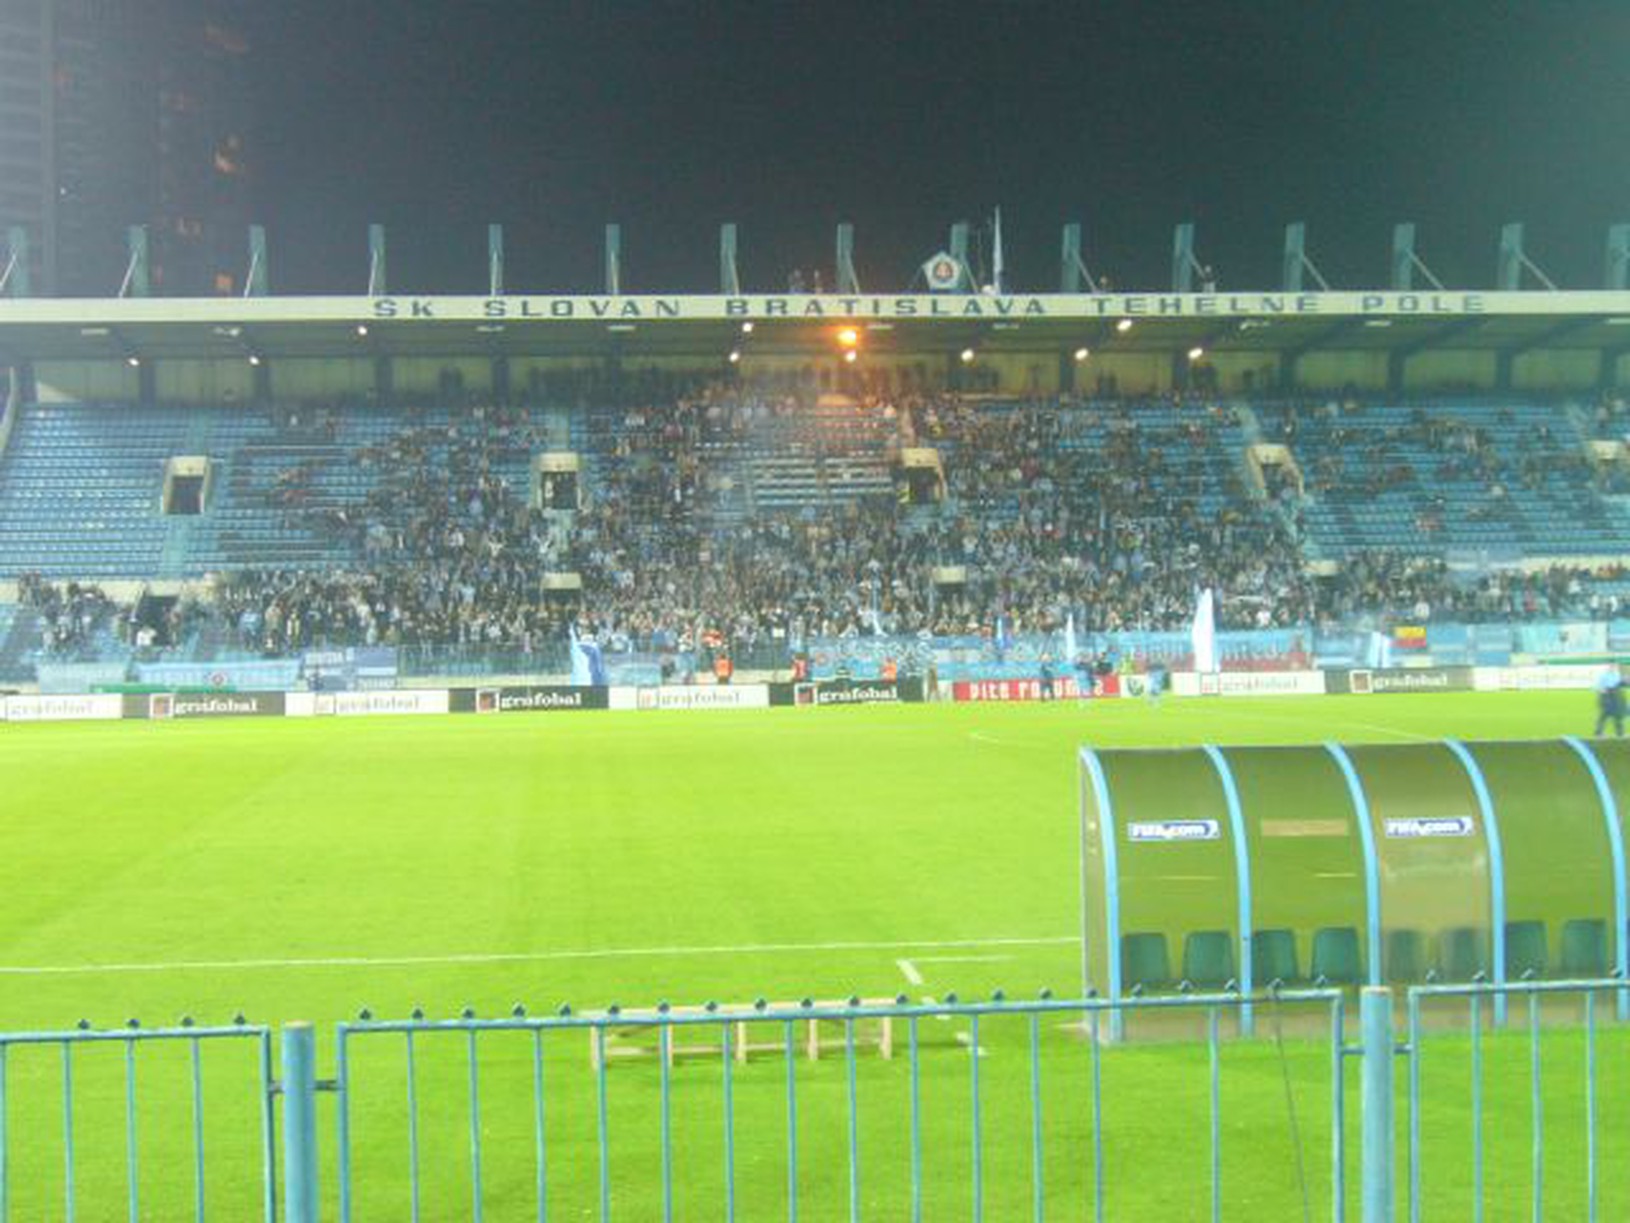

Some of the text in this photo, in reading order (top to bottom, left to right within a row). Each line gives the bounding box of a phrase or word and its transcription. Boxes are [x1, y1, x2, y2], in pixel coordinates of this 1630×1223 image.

[374, 299, 433, 317] SK
[483, 299, 680, 317] SLOVAN
[725, 298, 1047, 317] BRATISLAVA
[1362, 295, 1486, 313] POLE
